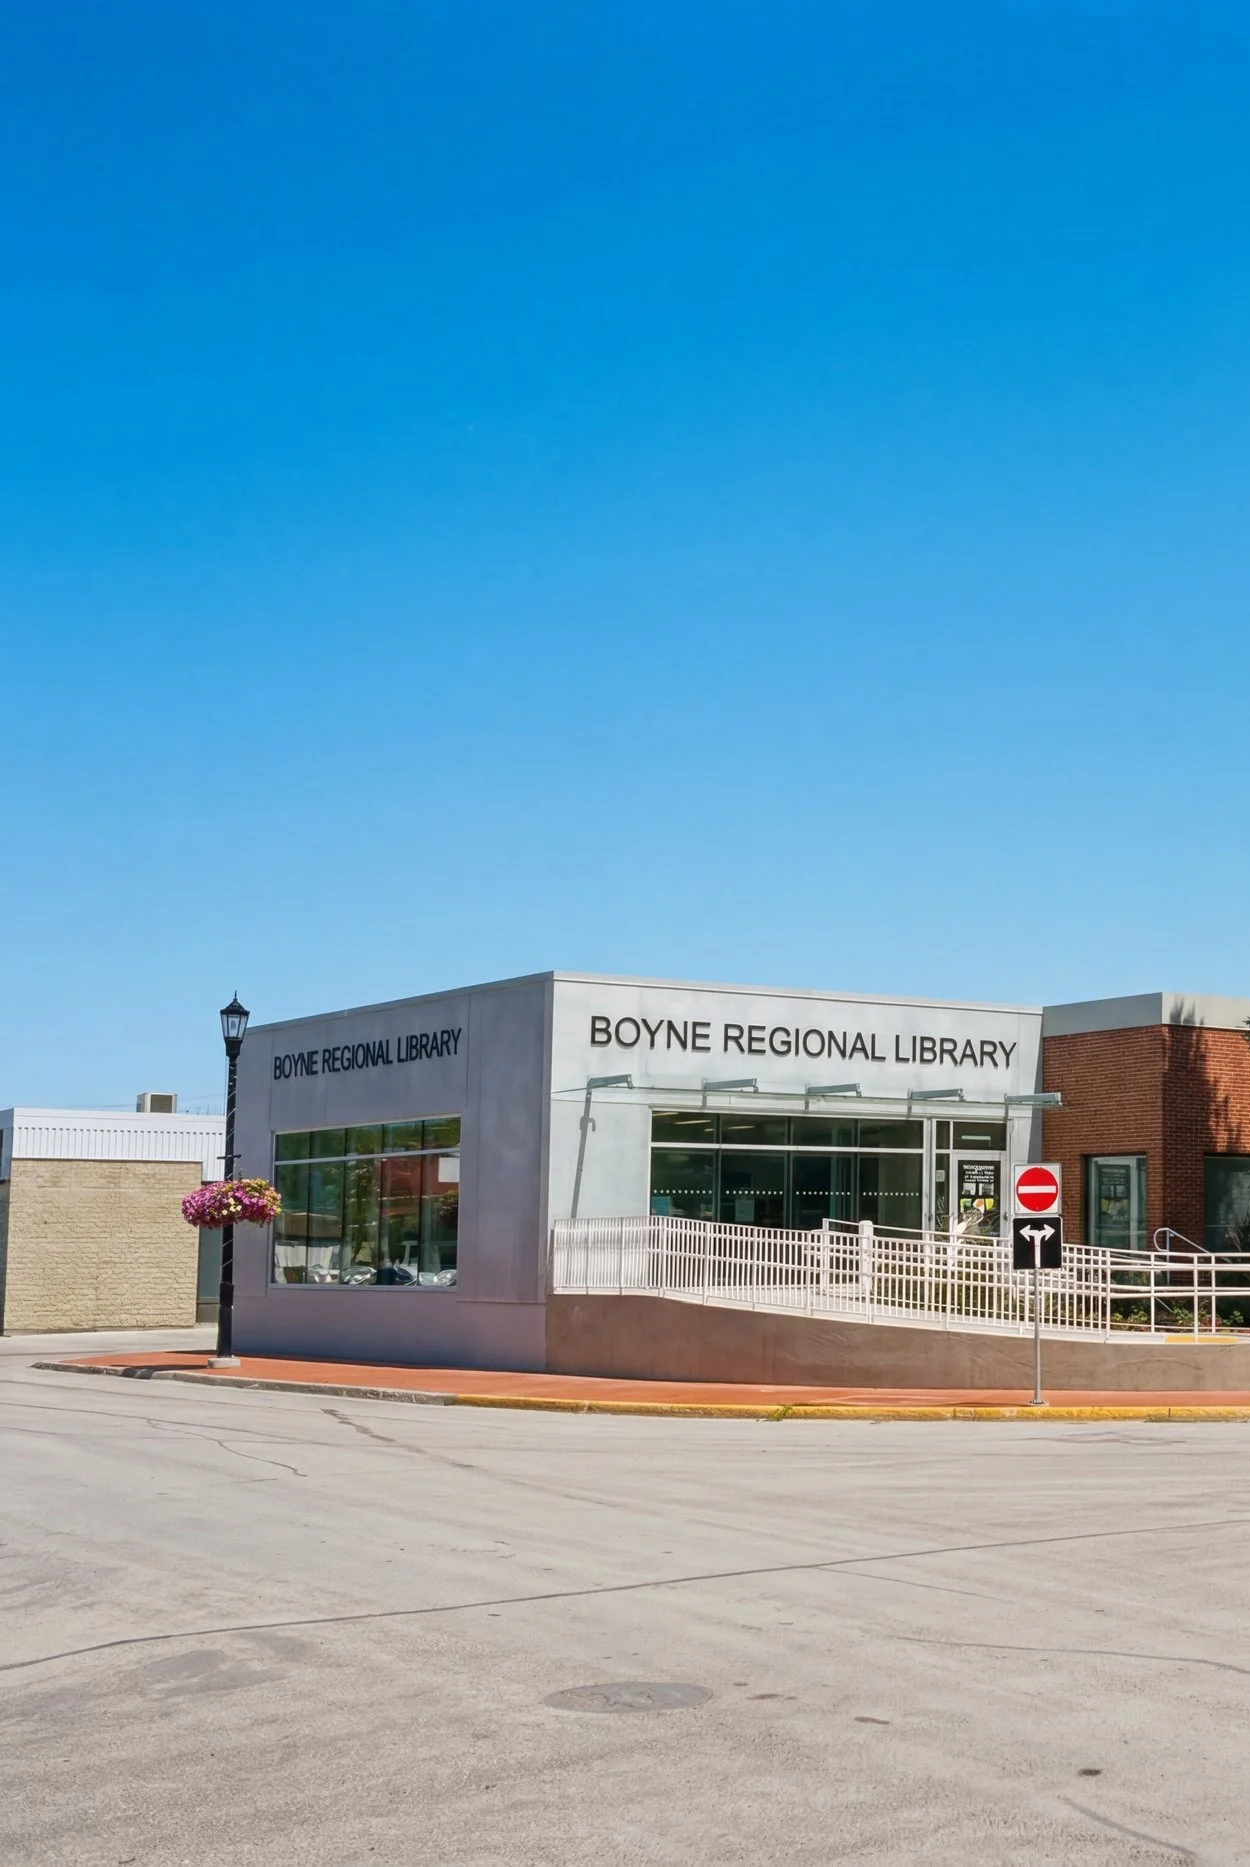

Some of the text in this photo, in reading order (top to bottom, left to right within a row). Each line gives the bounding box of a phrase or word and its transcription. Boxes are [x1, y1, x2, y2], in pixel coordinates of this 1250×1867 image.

[273, 1028, 462, 1080] BOYNE REGIONAL LIBRARY
[590, 1015, 1017, 1069] BOYNE REGIONAL LIBRARY
